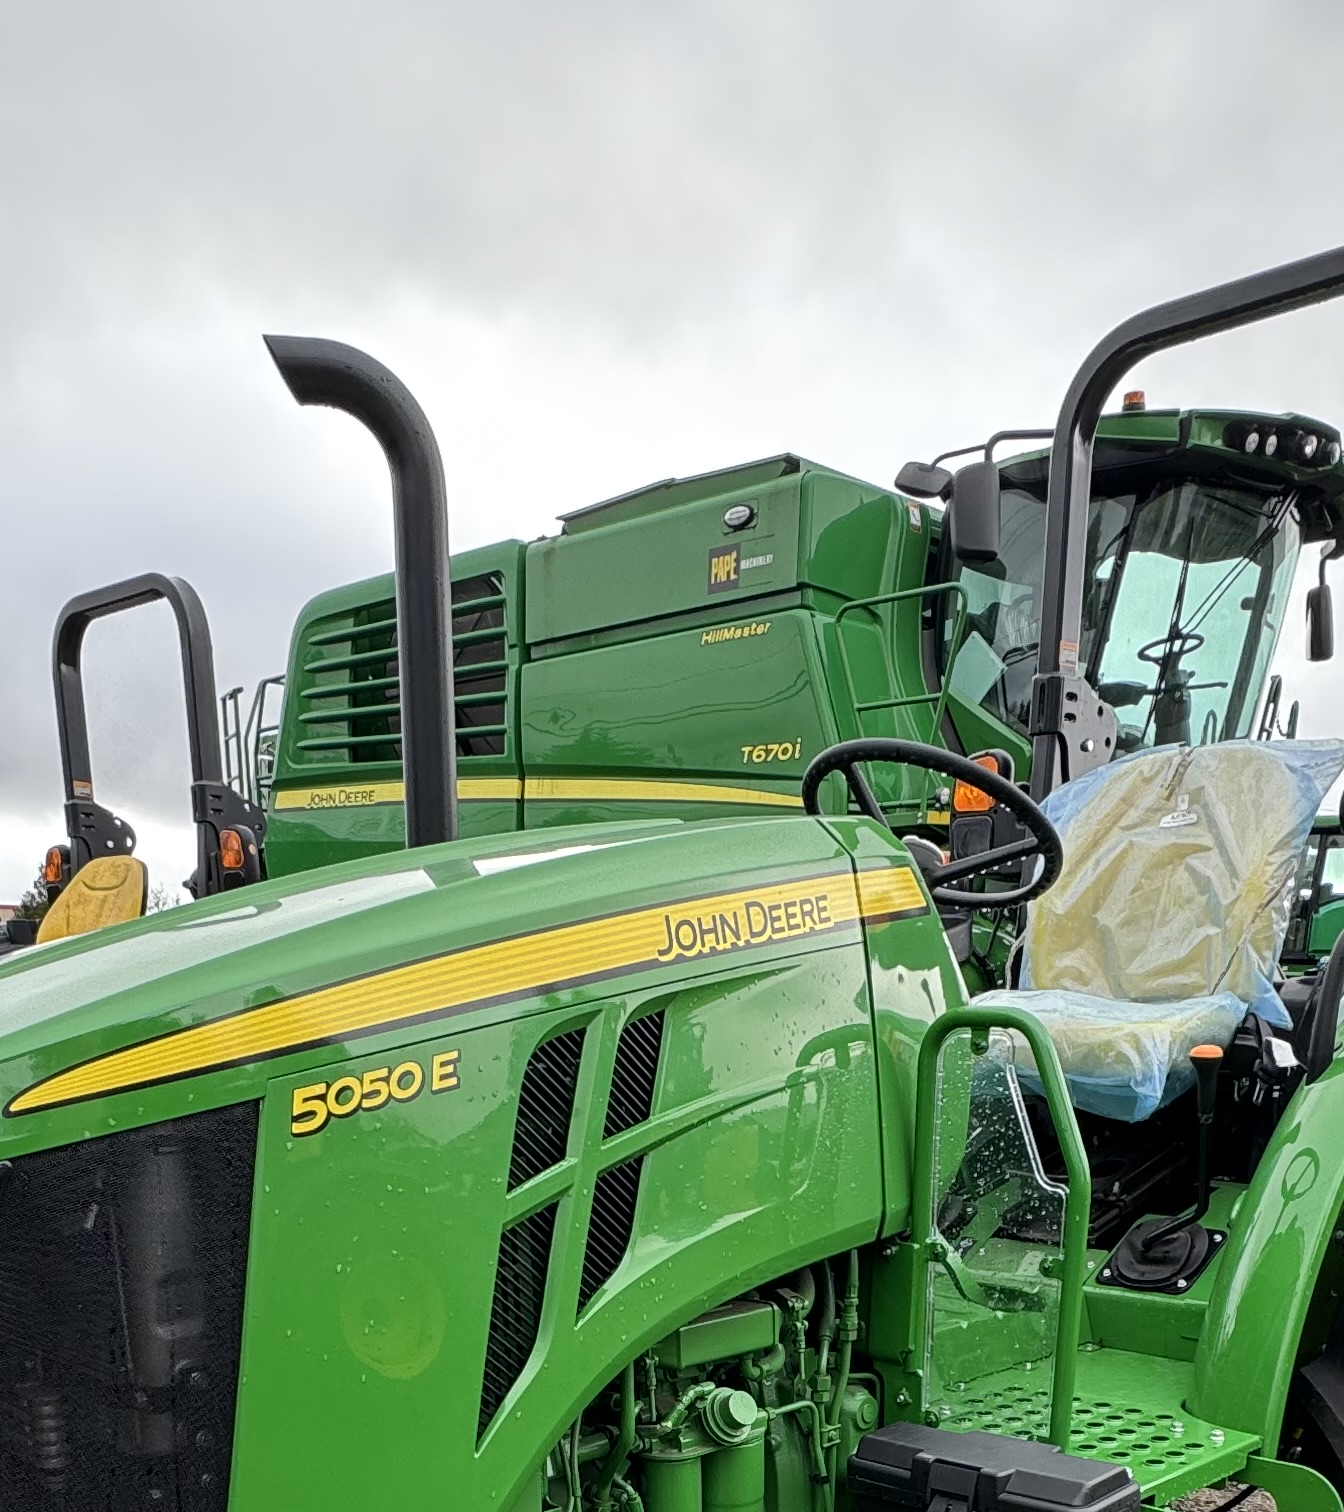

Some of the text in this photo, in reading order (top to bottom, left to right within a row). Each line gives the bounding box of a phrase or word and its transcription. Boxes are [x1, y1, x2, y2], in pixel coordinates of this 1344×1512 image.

[700, 622, 772, 646] HillMaster
[306, 789, 376, 806] JOHN DEERE
[657, 894, 832, 957] JOHN DEERE
[290, 1048, 462, 1138] 5050 E
